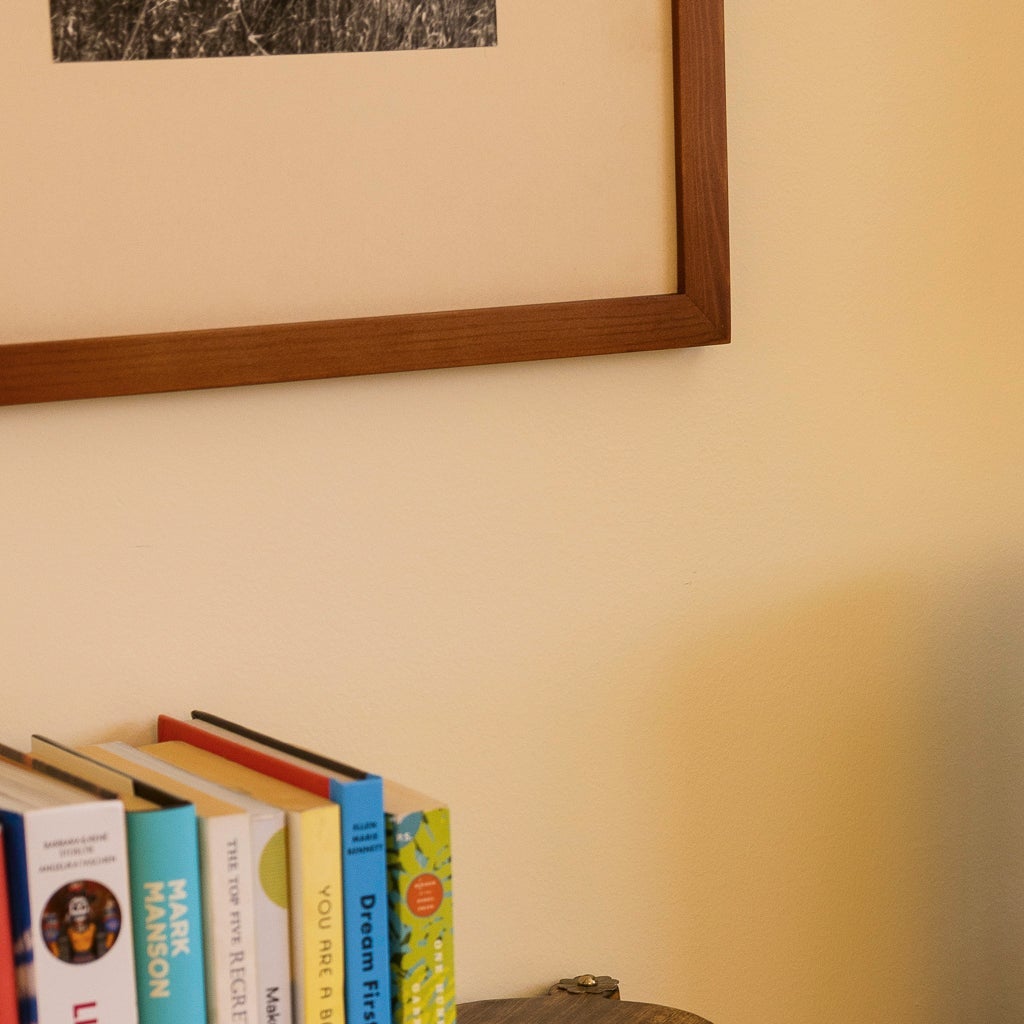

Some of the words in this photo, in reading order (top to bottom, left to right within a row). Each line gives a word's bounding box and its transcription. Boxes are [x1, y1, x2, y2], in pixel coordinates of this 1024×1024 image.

[226, 840, 238, 872] THE
[228, 874, 240, 906] TOP
[317, 885, 332, 931] YOU
[168, 878, 190, 957] MARK
[230, 910, 243, 945] FIVE
[359, 894, 376, 973] Dream
[143, 881, 170, 999] MANSON
[434, 939, 444, 974] ONE
[318, 940, 333, 978] ARE
[320, 987, 333, 999] A
